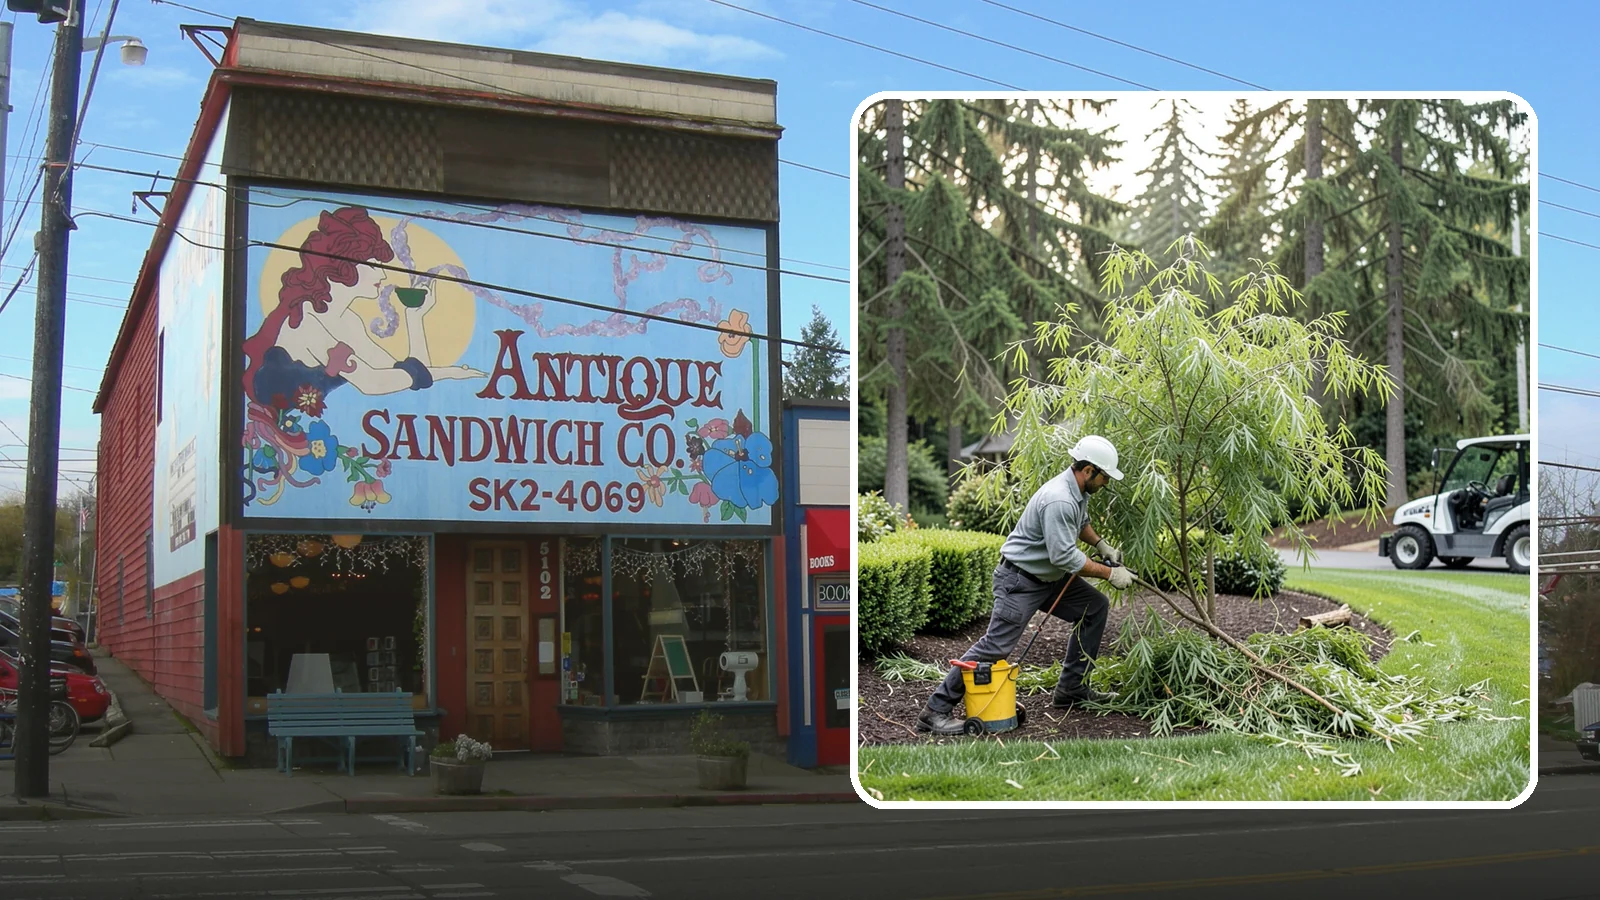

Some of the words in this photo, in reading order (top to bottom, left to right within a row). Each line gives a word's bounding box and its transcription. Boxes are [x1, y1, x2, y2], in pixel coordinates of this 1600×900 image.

[475, 329, 723, 421] ANTIQUE
[361, 408, 605, 467] SANDWICH
[617, 422, 685, 468] CO.
[468, 477, 645, 512] SK2-4069
[540, 541, 551, 599] 5102
[809, 555, 835, 569] BOOKS
